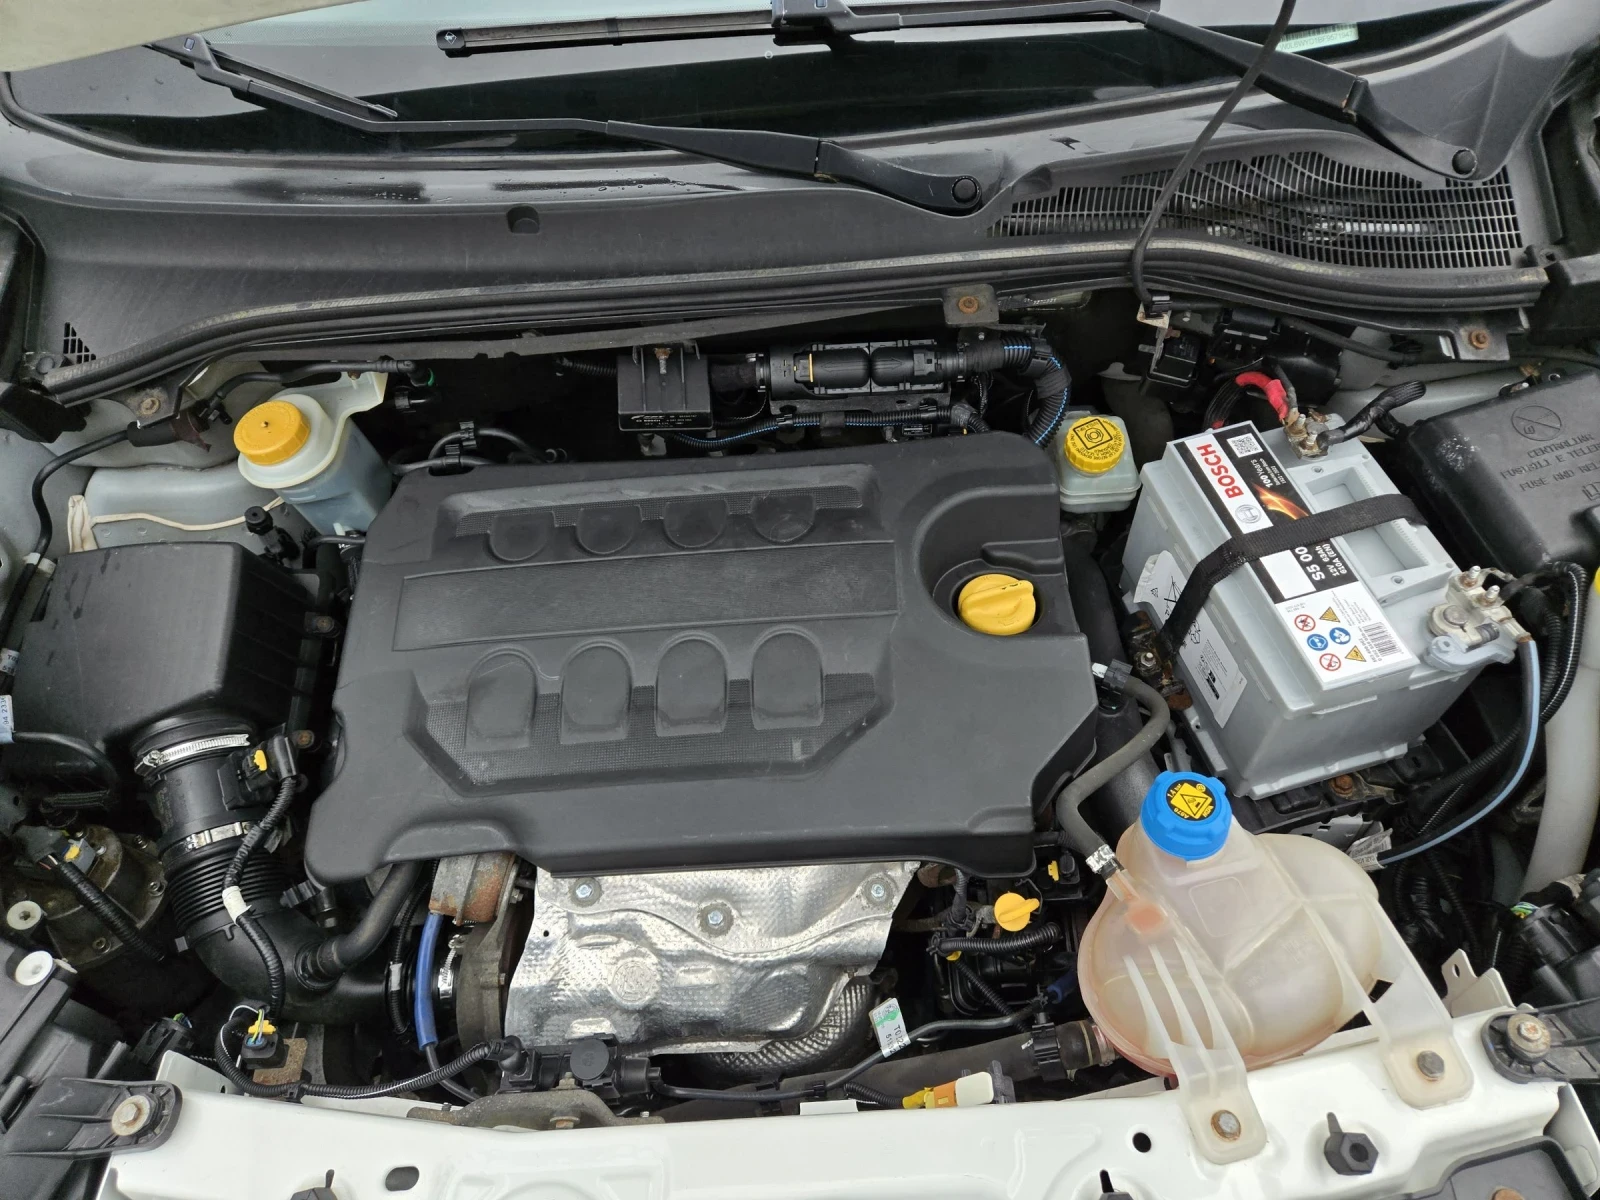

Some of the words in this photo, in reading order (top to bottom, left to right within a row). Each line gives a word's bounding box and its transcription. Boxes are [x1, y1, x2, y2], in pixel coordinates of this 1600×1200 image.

[1555, 454, 1566, 462] E
[1197, 444, 1244, 498] BOSCH
[1250, 458, 1264, 476] Years
[1260, 474, 1274, 488] 100
[1520, 478, 1550, 492] FUSE
[1552, 470, 1575, 482] AND
[1315, 546, 1330, 562] 63Ah
[1322, 544, 1336, 558] (EN)
[1306, 564, 1326, 580] S5
[1326, 564, 1340, 576] 12V
[1333, 558, 1348, 574] 610A
